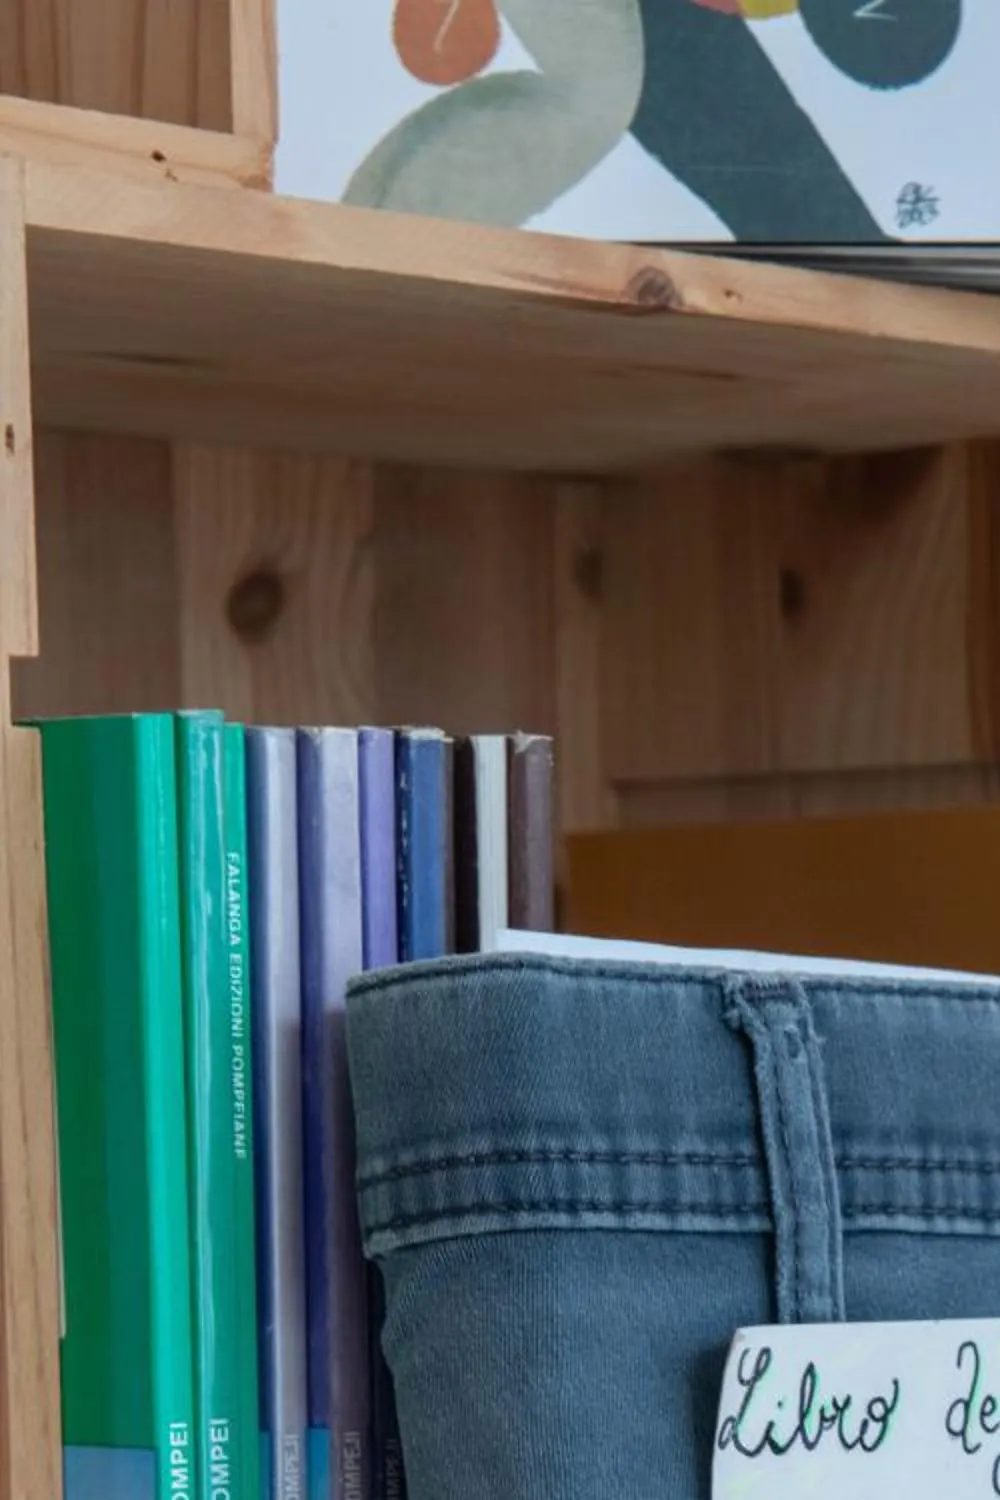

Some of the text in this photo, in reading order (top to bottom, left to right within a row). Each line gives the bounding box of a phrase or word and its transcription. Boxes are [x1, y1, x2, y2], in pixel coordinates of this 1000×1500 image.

[225, 851, 242, 946] FALANGA
[228, 953, 245, 1038] EDIZIONI
[718, 1347, 899, 1457] Libro
